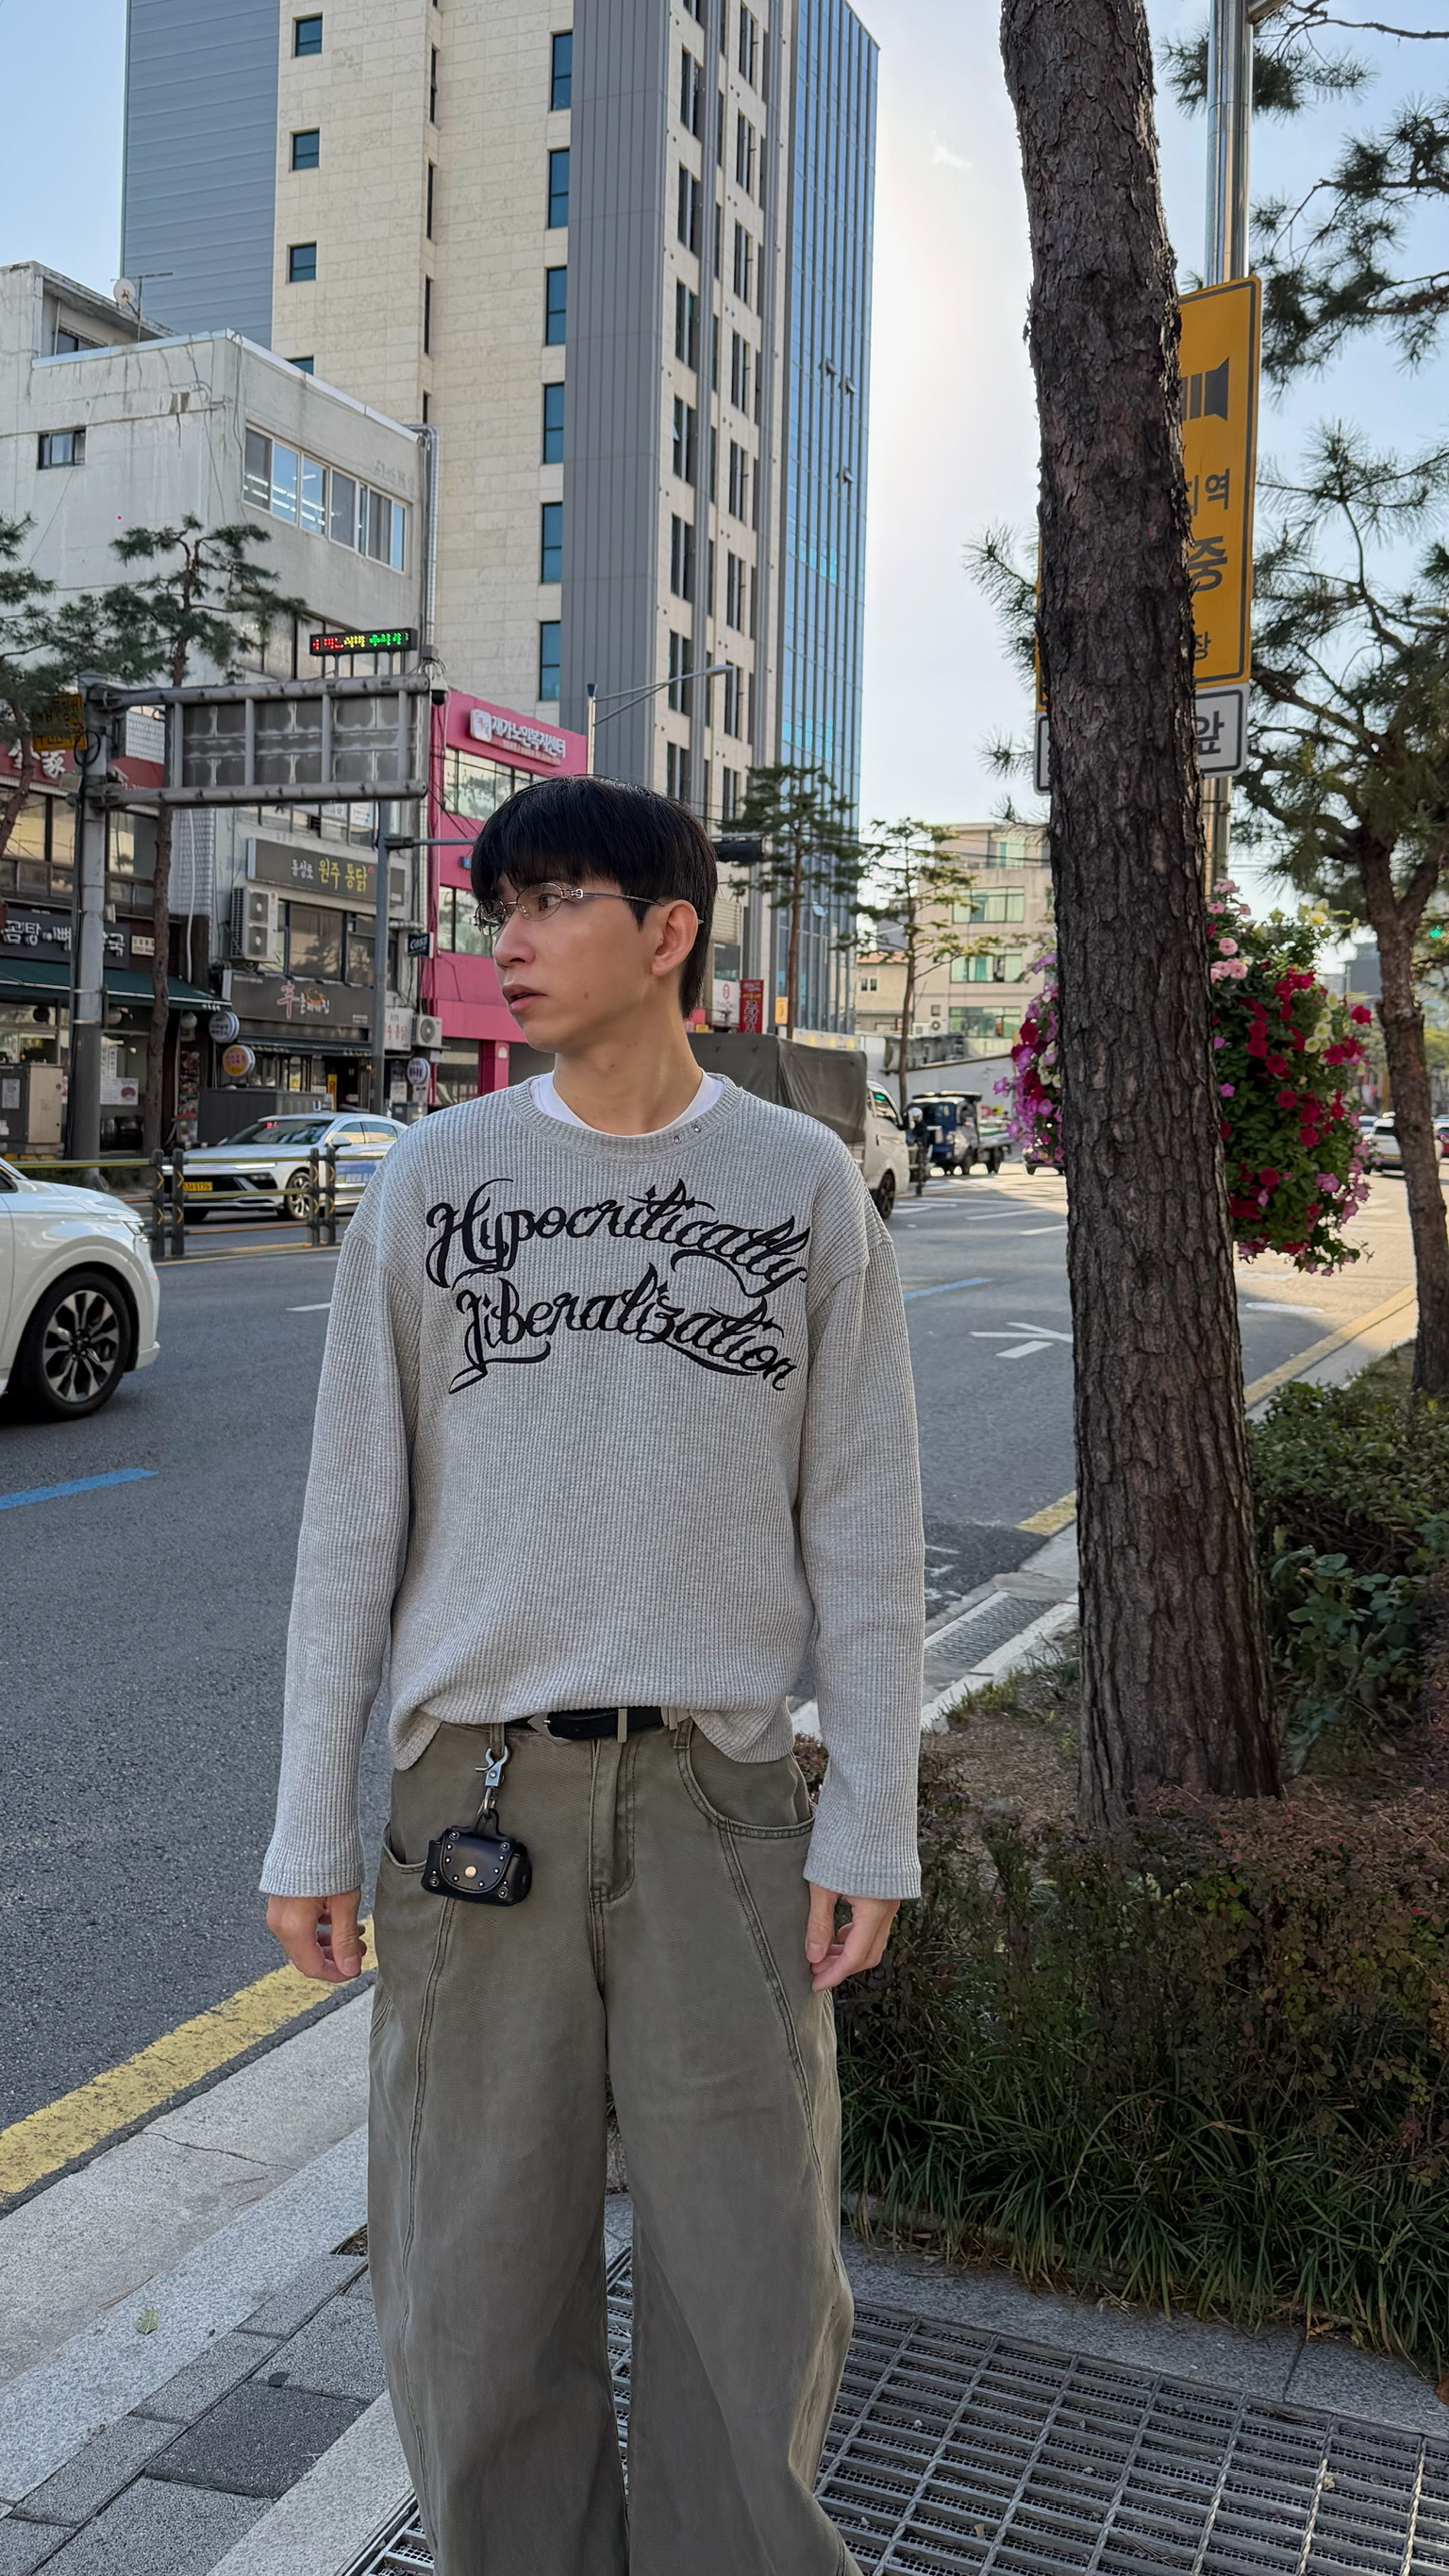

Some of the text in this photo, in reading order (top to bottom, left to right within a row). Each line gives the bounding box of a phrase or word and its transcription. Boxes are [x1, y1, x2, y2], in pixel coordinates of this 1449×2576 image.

[319, 858, 341, 891] 원주
[345, 862, 367, 893] 통닭
[425, 1178, 809, 1297] Hypocritically
[448, 1262, 797, 1395] Liberalization
